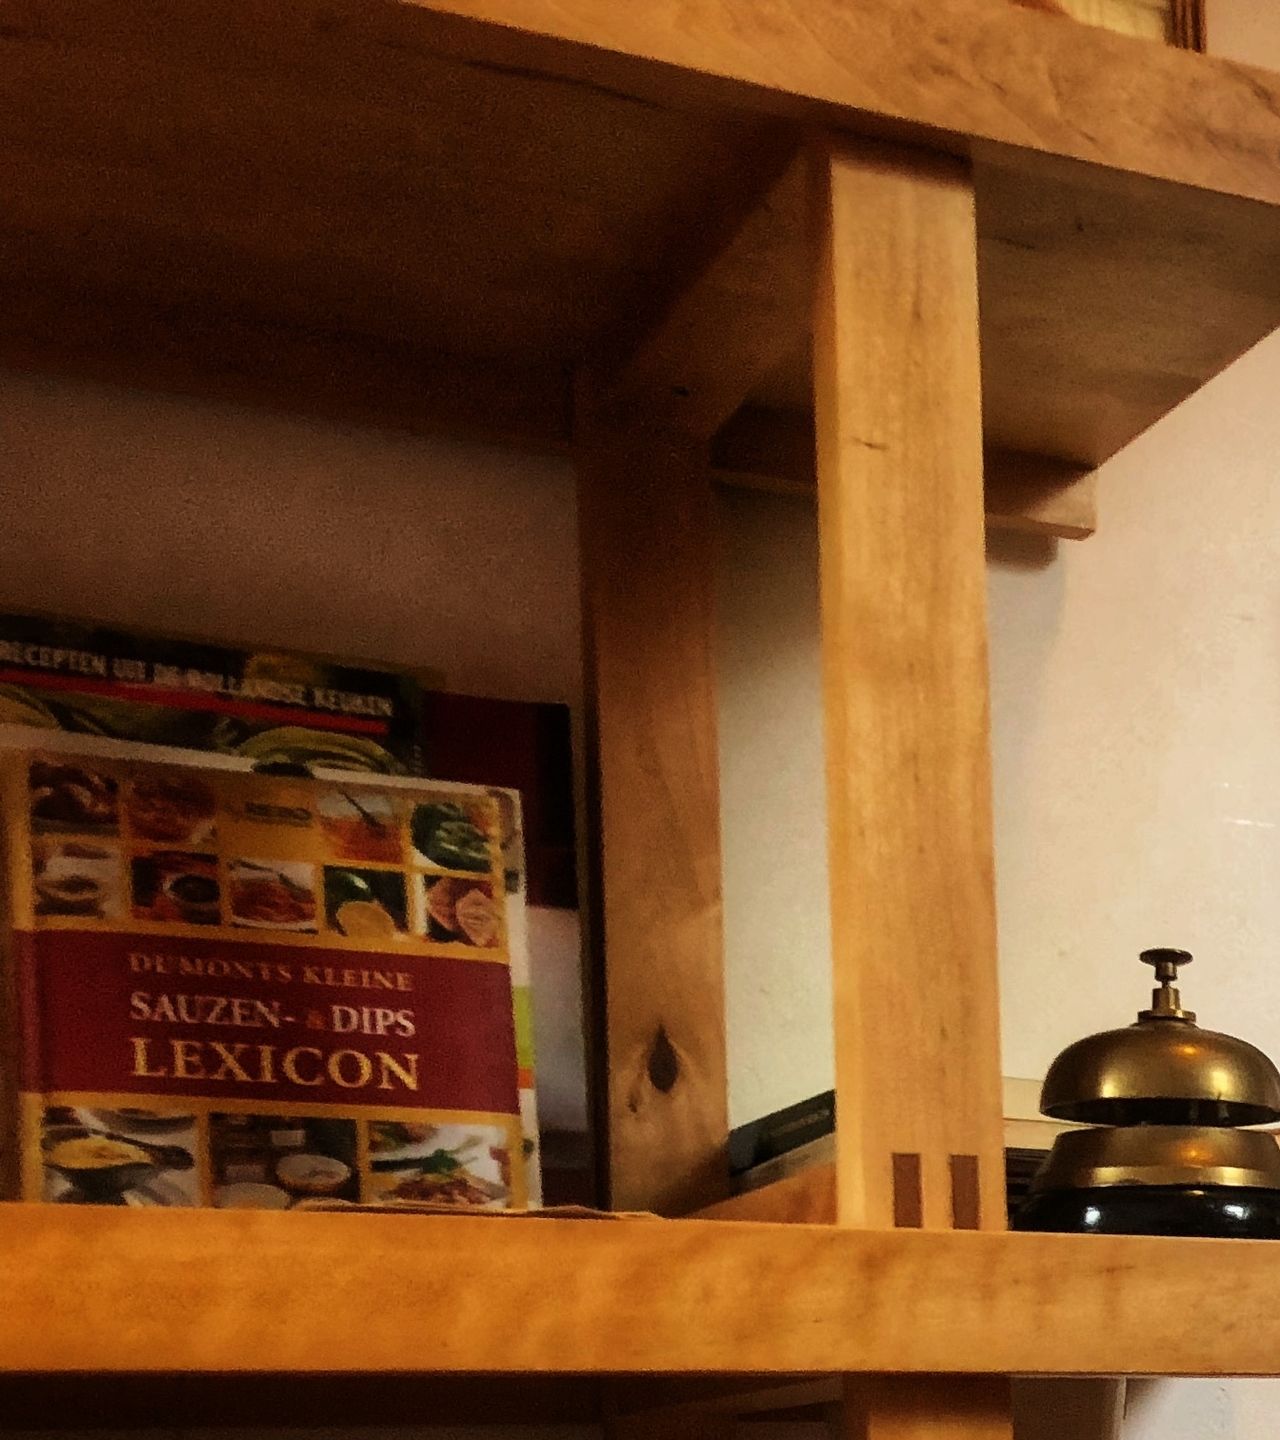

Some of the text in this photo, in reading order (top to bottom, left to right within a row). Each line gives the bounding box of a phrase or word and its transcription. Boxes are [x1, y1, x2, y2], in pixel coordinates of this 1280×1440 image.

[303, 964, 414, 991] KLEINE
[129, 991, 295, 1029] SAUZEN-
[331, 1004, 416, 1037] DIPS
[130, 1036, 419, 1092] LEXICON
